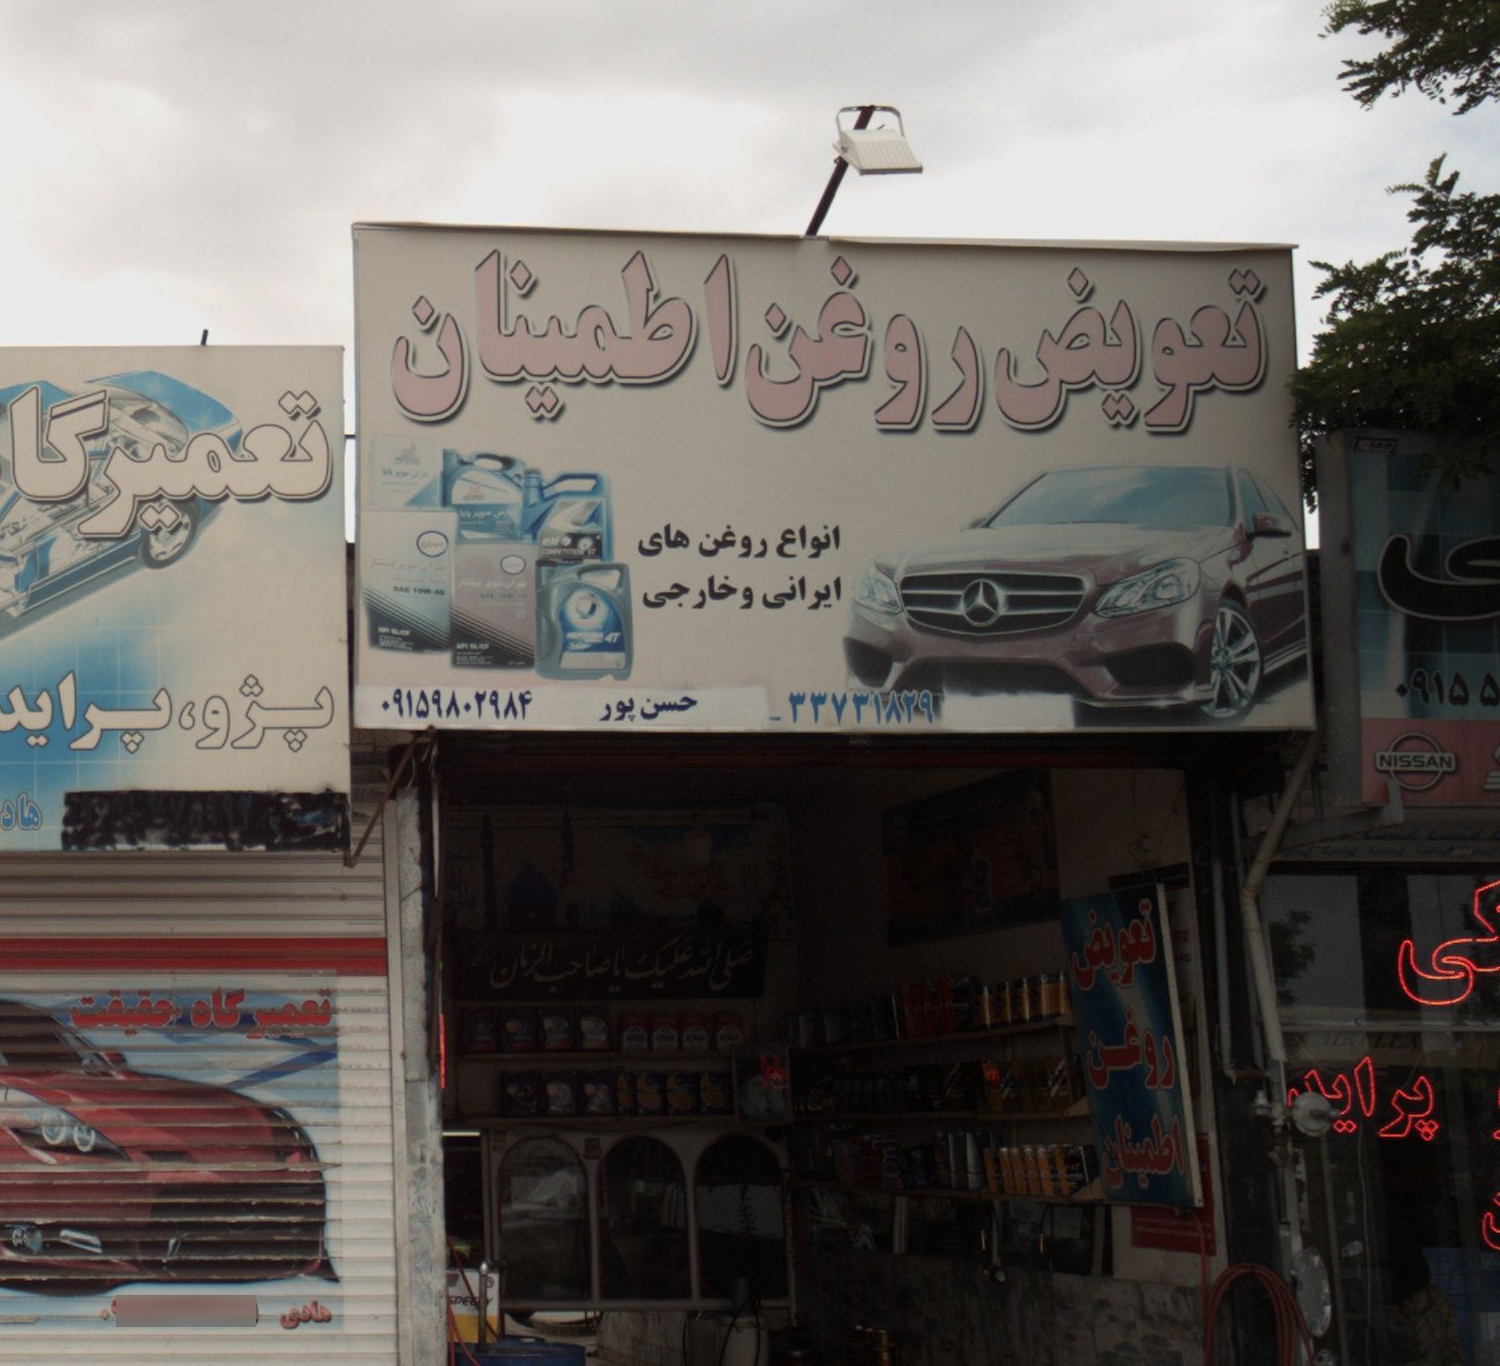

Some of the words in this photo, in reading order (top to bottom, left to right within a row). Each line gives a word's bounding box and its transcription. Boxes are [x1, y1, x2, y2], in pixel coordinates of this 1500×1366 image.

[390, 248, 736, 425] اطمینان
[744, 254, 990, 432] روغن
[993, 265, 1271, 436] تعویض
[638, 523, 690, 557] های
[698, 524, 768, 558] روغن
[776, 524, 840, 558] انواع
[762, 576, 841, 610] ایرانی
[381, 688, 533, 720] ۰۹۱۵۹۸۰۲۹۸۴
[640, 693, 698, 720] حسن
[788, 690, 934, 724] ۳۳۷۳۱۸۲۹
[1379, 755, 1452, 768] NISSAN
[1071, 897, 1156, 992] تعویض
[70, 989, 182, 1036] حقیقت
[1086, 1006, 1176, 1091] روغن
[1102, 1112, 1185, 1190] اطمینان
[280, 1300, 332, 1329] هادی
